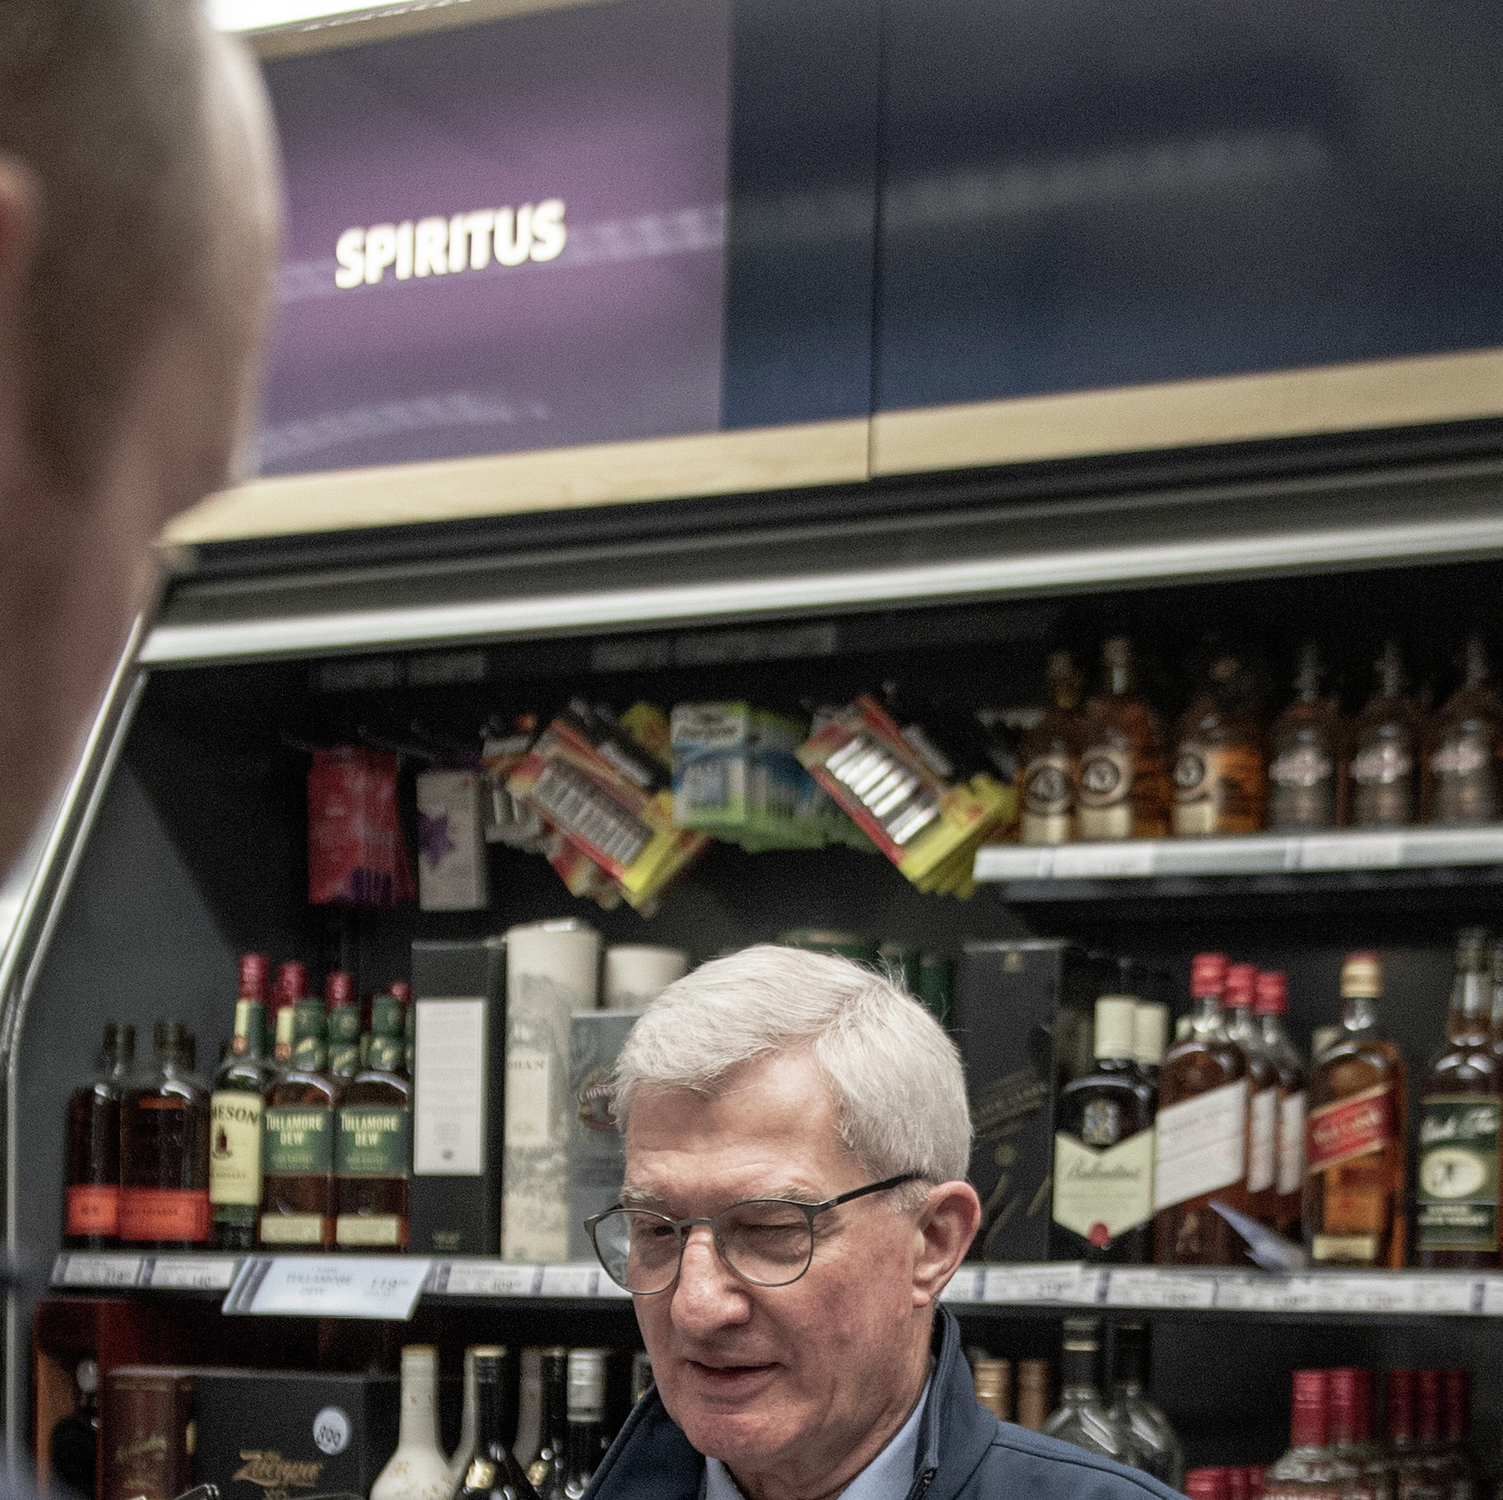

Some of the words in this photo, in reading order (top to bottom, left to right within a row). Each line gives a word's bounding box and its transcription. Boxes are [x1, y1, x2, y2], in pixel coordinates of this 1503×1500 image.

[334, 199, 566, 288] SPIRITUS
[266, 1114, 323, 1131] TULLAMORE
[342, 1114, 398, 1131] TULLAMORE
[280, 1132, 305, 1146] DEW
[355, 1132, 380, 1146] DEW
